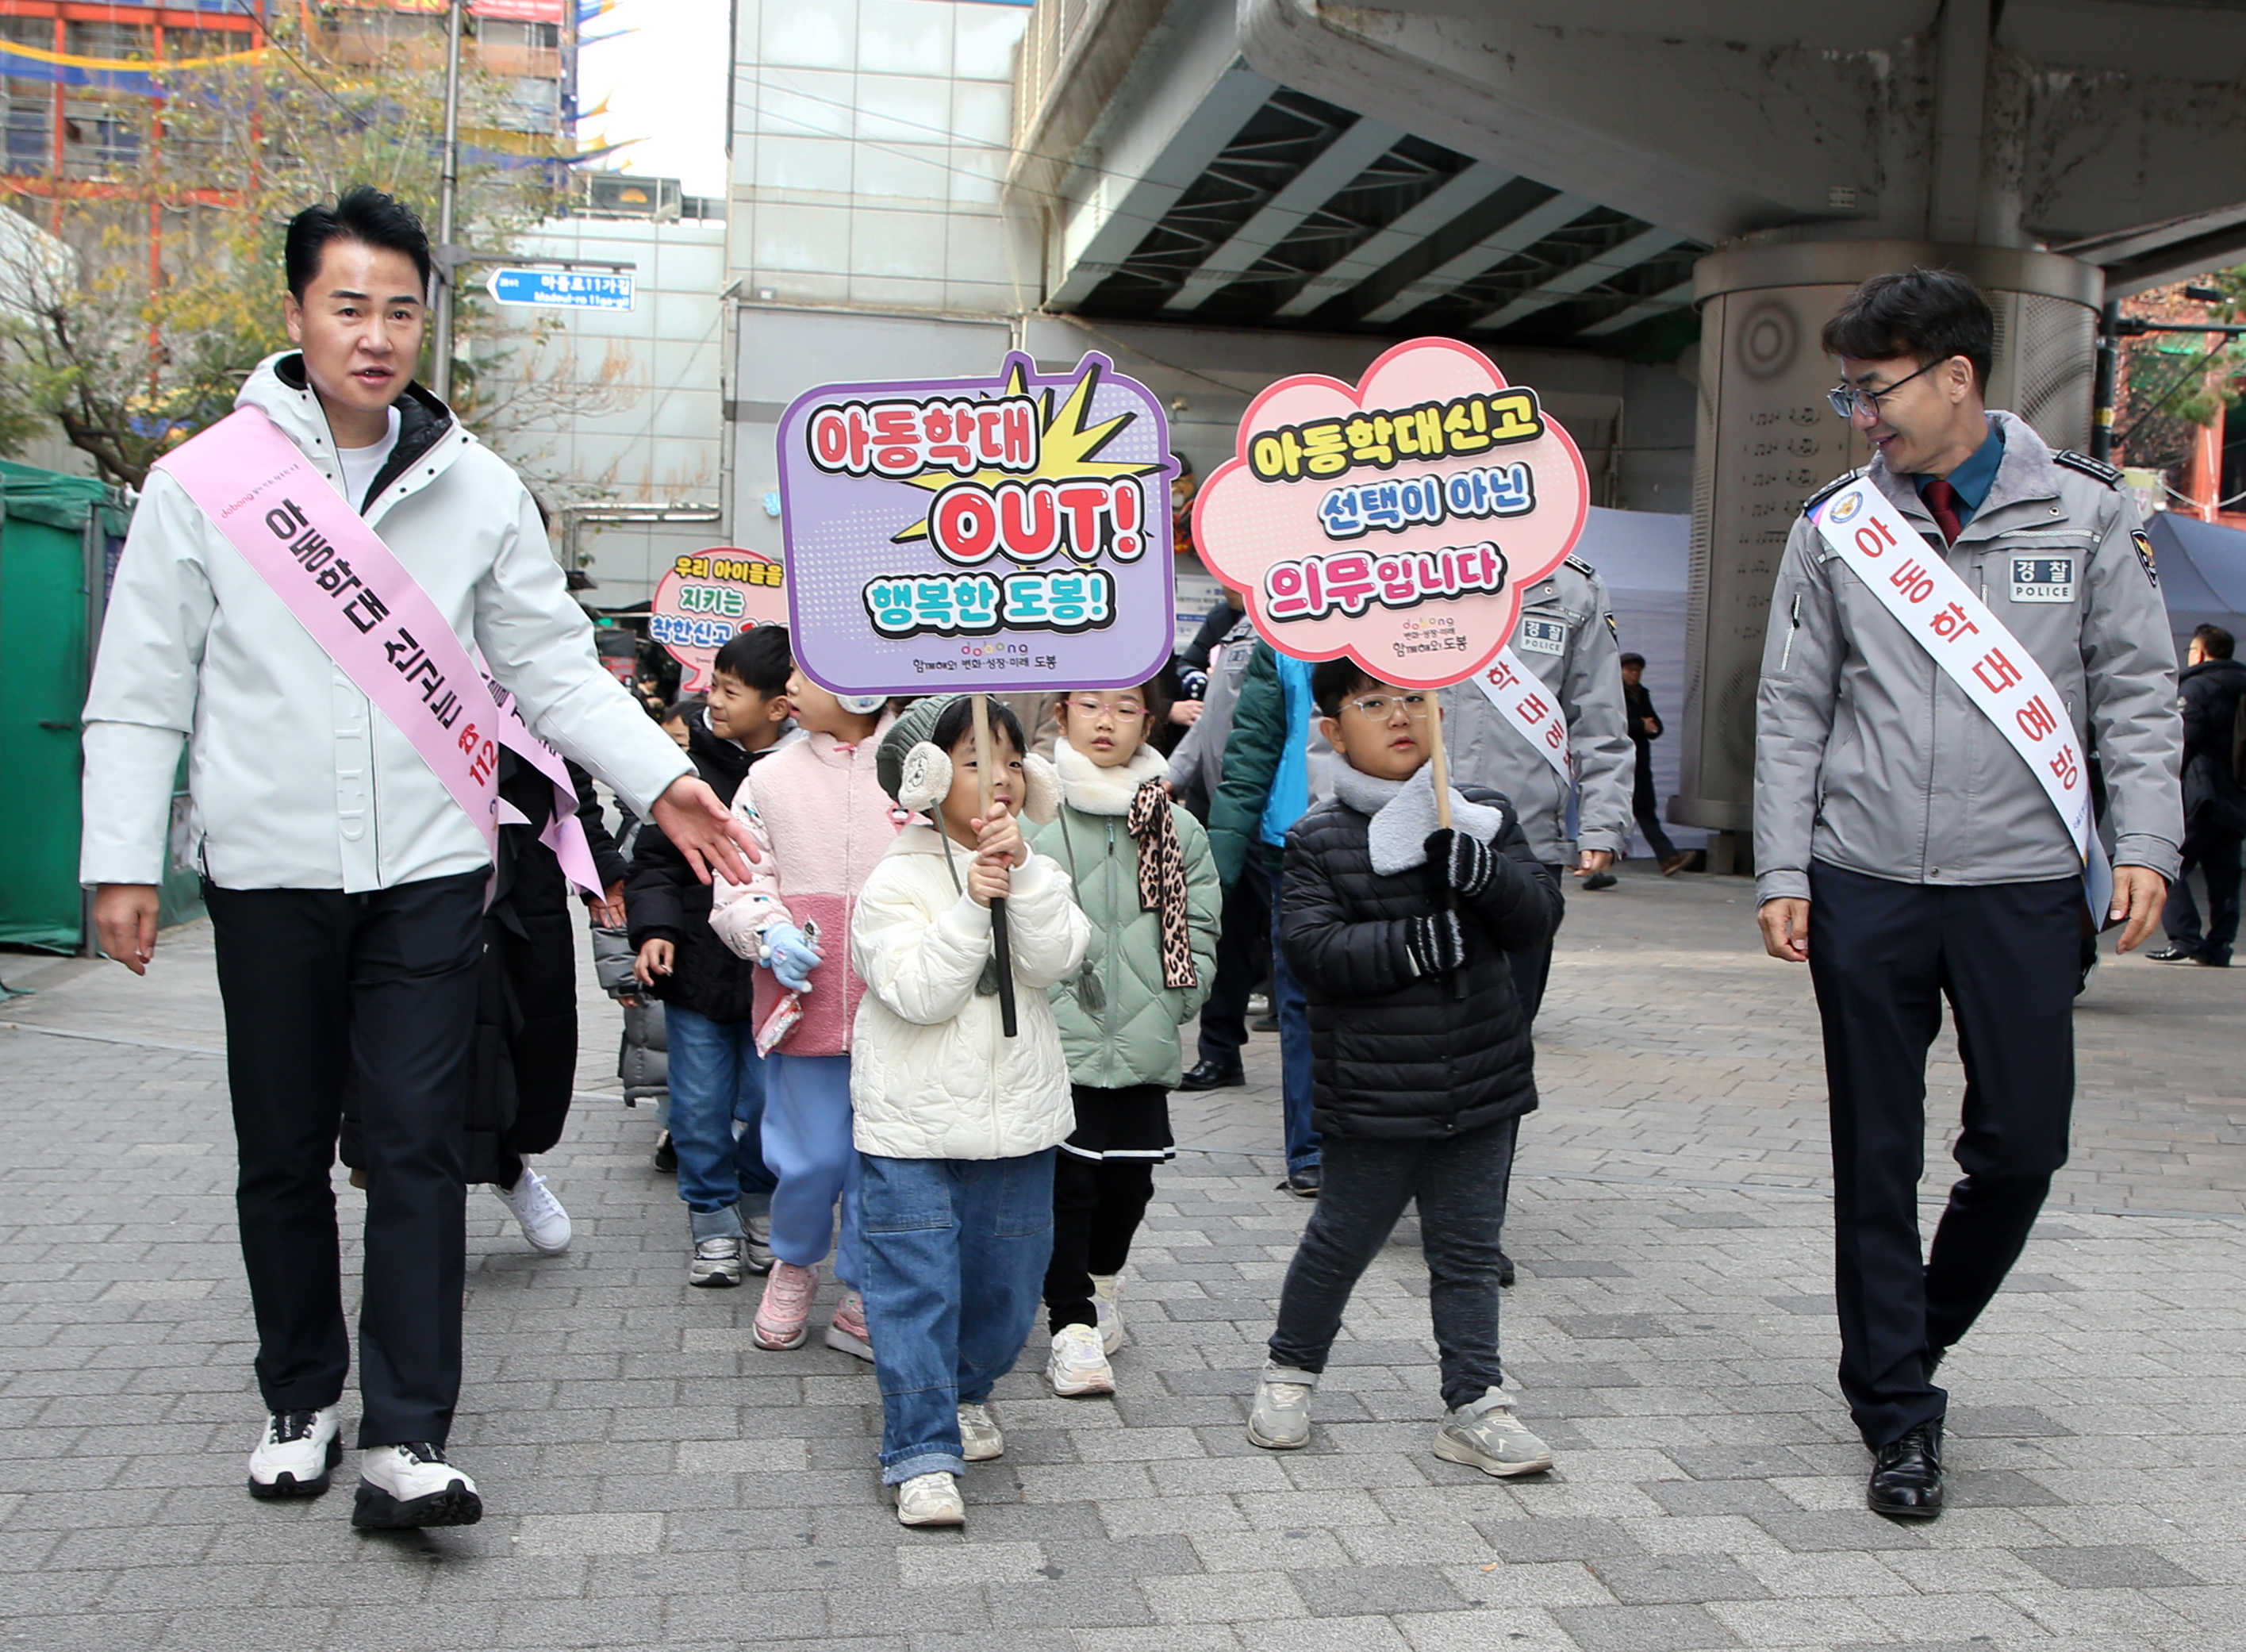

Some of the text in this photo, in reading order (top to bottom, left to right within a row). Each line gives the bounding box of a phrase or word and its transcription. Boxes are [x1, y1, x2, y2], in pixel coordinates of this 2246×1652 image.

[540, 275, 630, 296] 마들로11가길
[814, 403, 1034, 472] 아동학대
[1254, 395, 1540, 478] 아동학대신고
[1323, 467, 1526, 532] 선택이 아닌
[935, 482, 1140, 558] OUT!
[674, 555, 784, 587] 우리 아이들을
[1271, 547, 1497, 613] 의무입니다
[681, 587, 743, 614] 지키는
[870, 576, 1106, 625] 행복한 도봉!
[2016, 586, 2068, 597] POLICE
[265, 498, 390, 635] 아동학대
[383, 626, 463, 729] 신고는
[470, 740, 498, 787] 112
[651, 617, 731, 645] 착한신고
[1443, 635, 1468, 651] 도봉
[1525, 639, 1561, 652] POLICE
[962, 641, 1028, 656] dobong
[1035, 655, 1057, 670] 도봉
